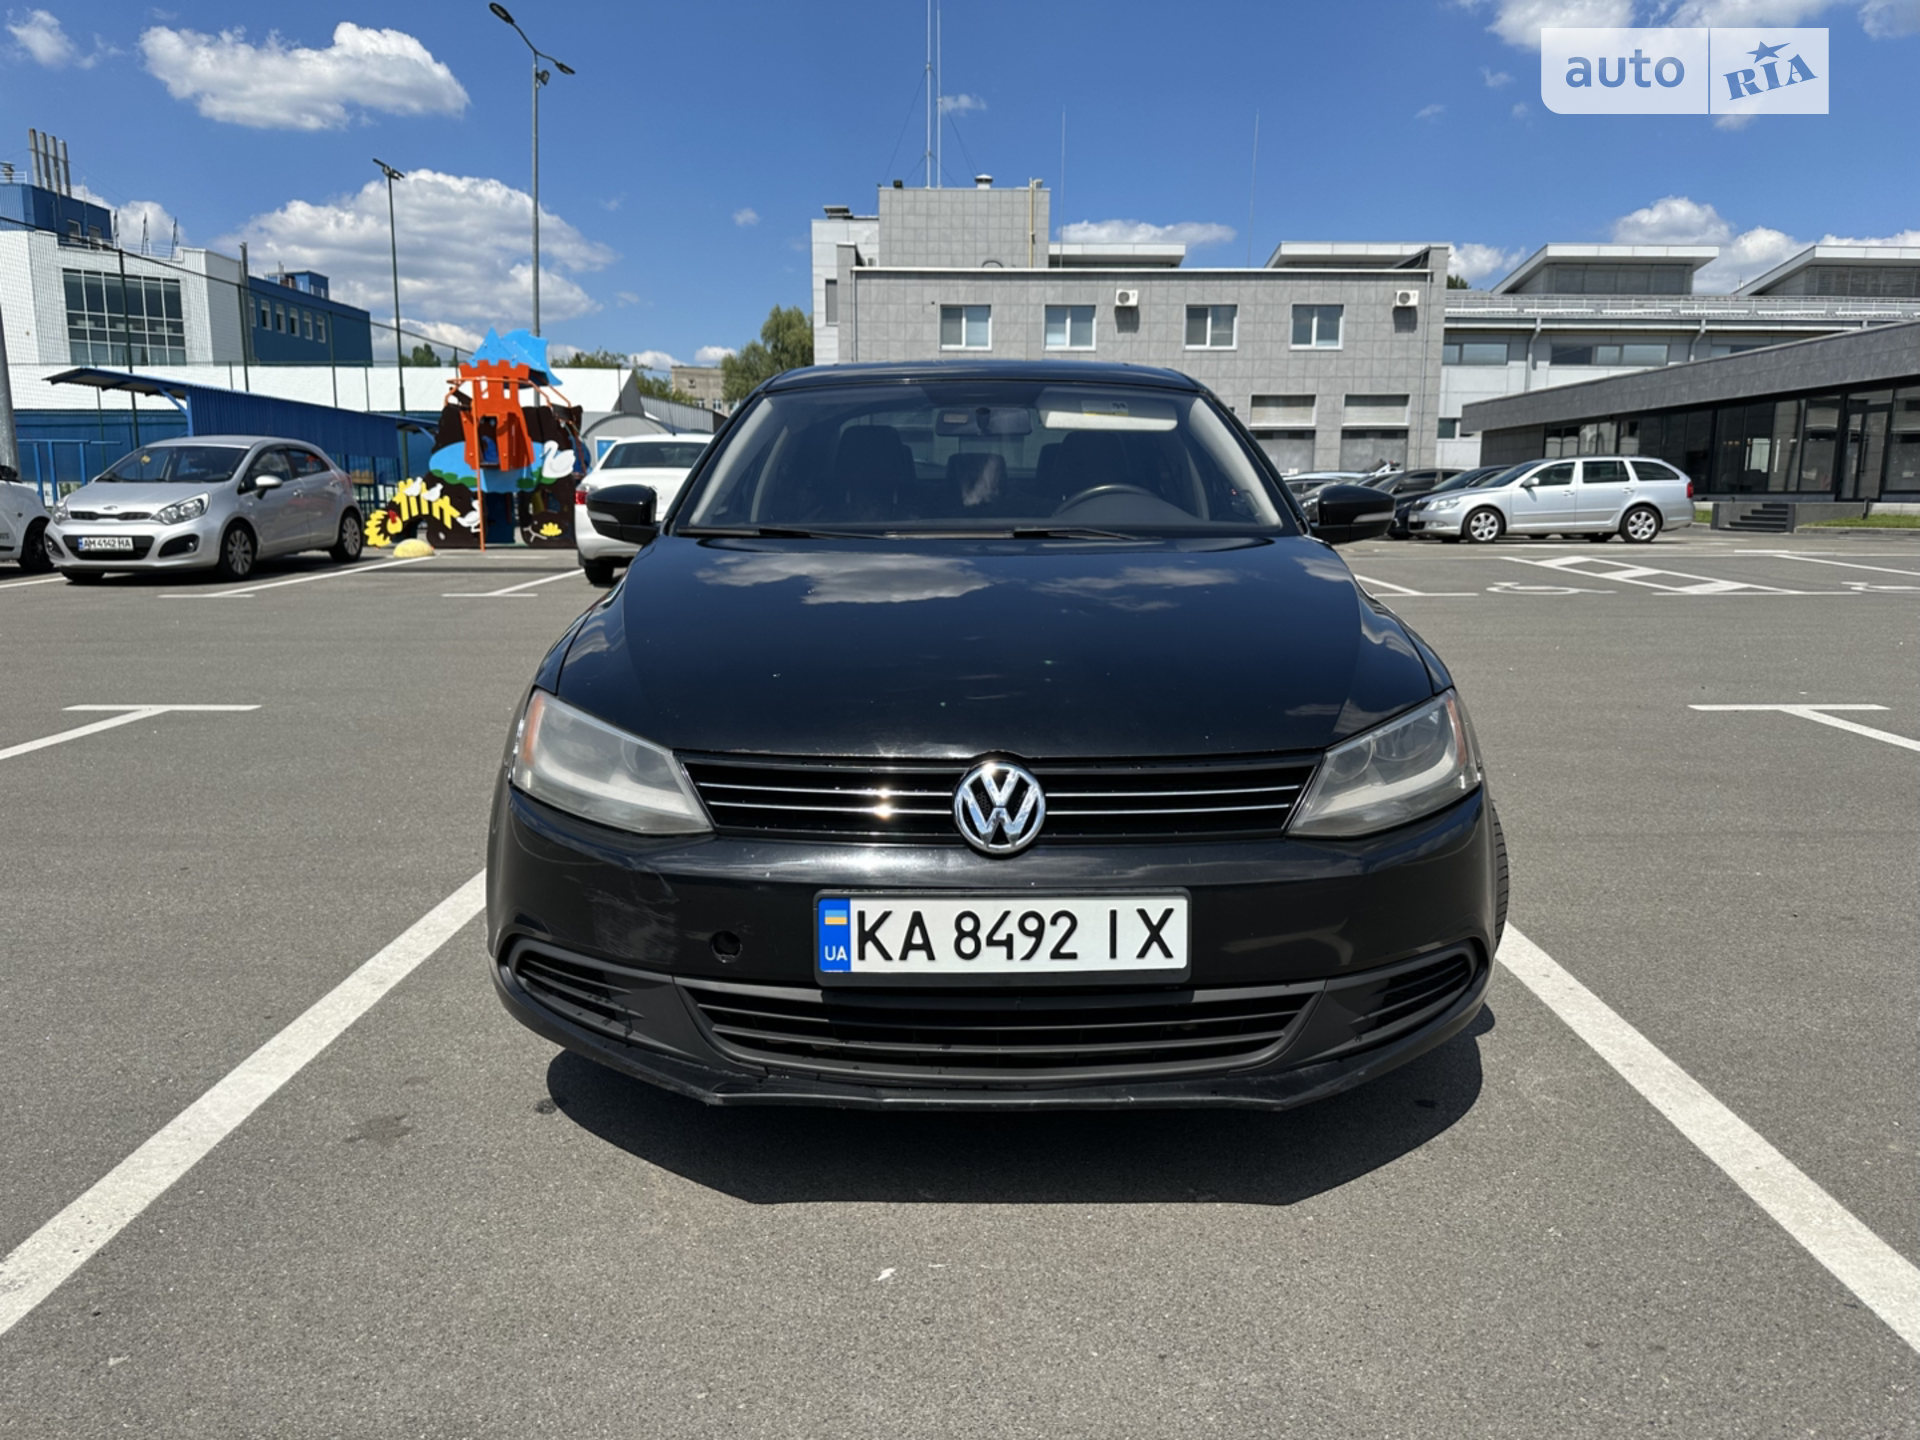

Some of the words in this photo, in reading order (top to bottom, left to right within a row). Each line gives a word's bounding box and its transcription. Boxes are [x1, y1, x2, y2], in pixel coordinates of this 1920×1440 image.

[954, 761, 1046, 853] VW
[824, 945, 848, 961] UA
[857, 910, 936, 961] KA
[953, 910, 1078, 961] 8492
[1109, 908, 1174, 960] IX
